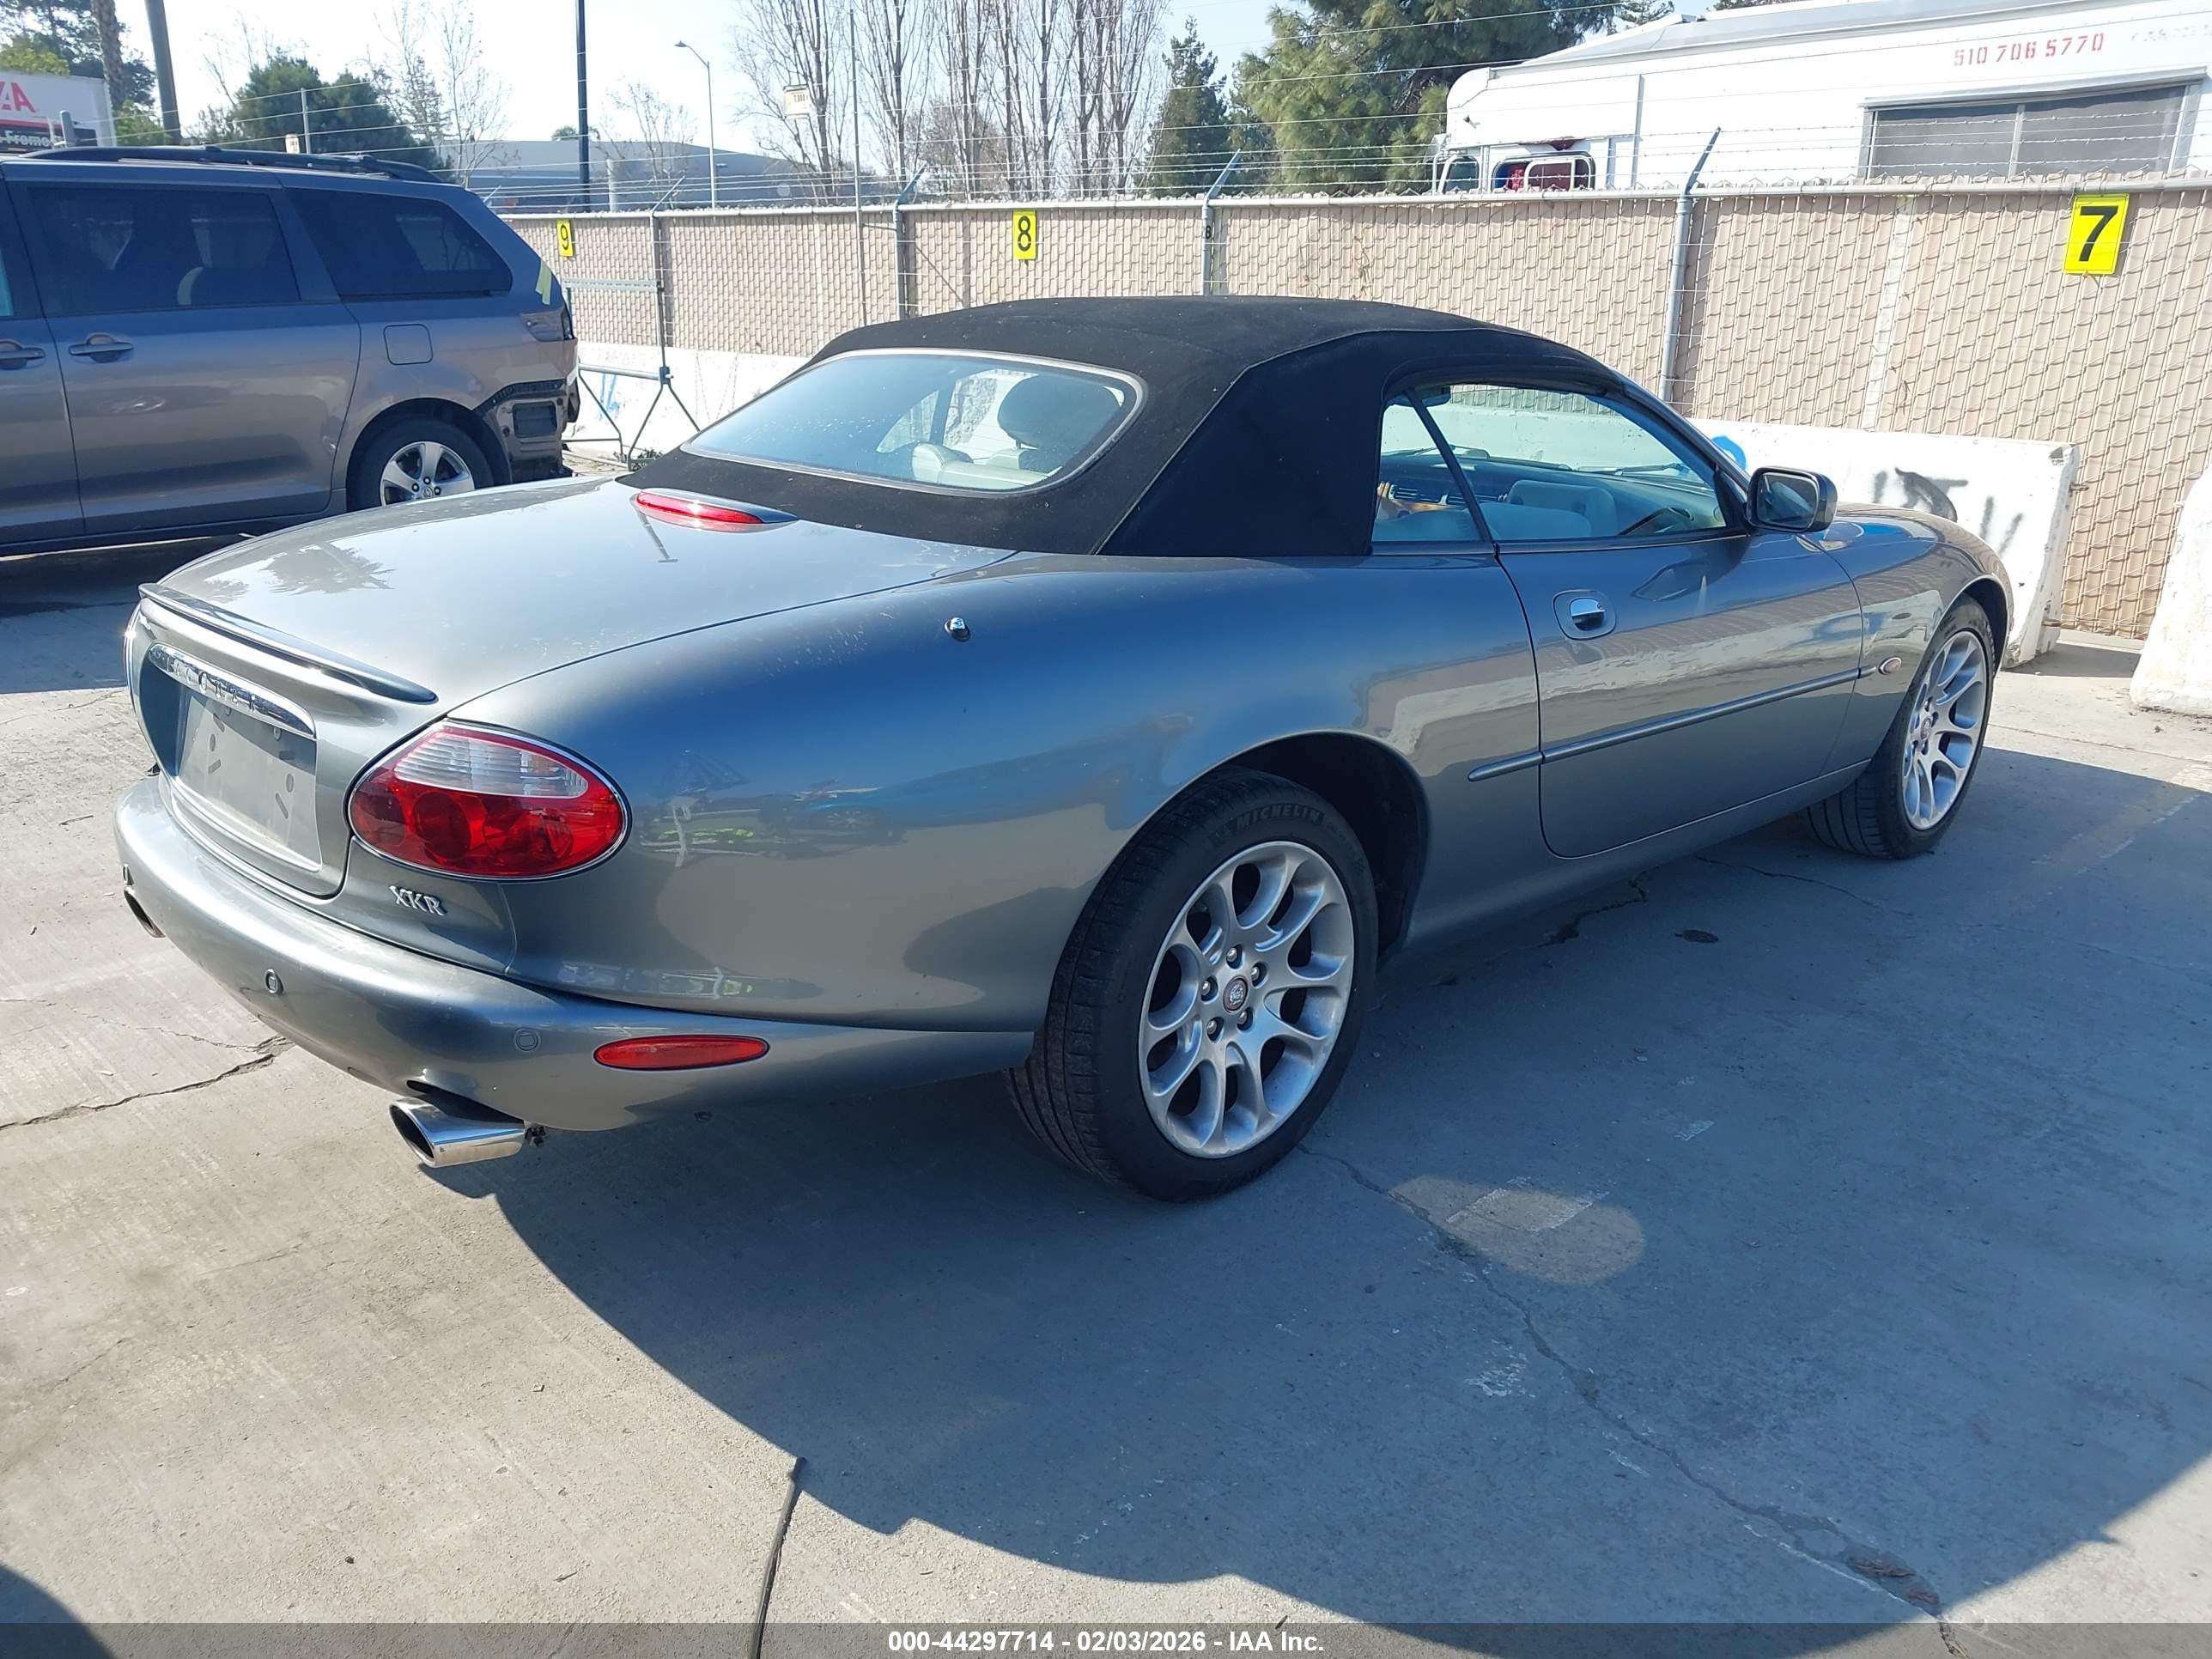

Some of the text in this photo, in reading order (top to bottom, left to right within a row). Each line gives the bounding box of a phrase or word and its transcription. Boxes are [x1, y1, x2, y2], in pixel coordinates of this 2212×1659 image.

[1954, 46, 1988, 67] 510
[1996, 40, 2037, 63] 706
[2045, 32, 2105, 58] 5770
[560, 224, 569, 251] 9
[1018, 216, 1032, 252] 8
[2078, 205, 2119, 262] 7
[1237, 803, 1324, 830] MICHELIN
[388, 885, 447, 917] XKR
